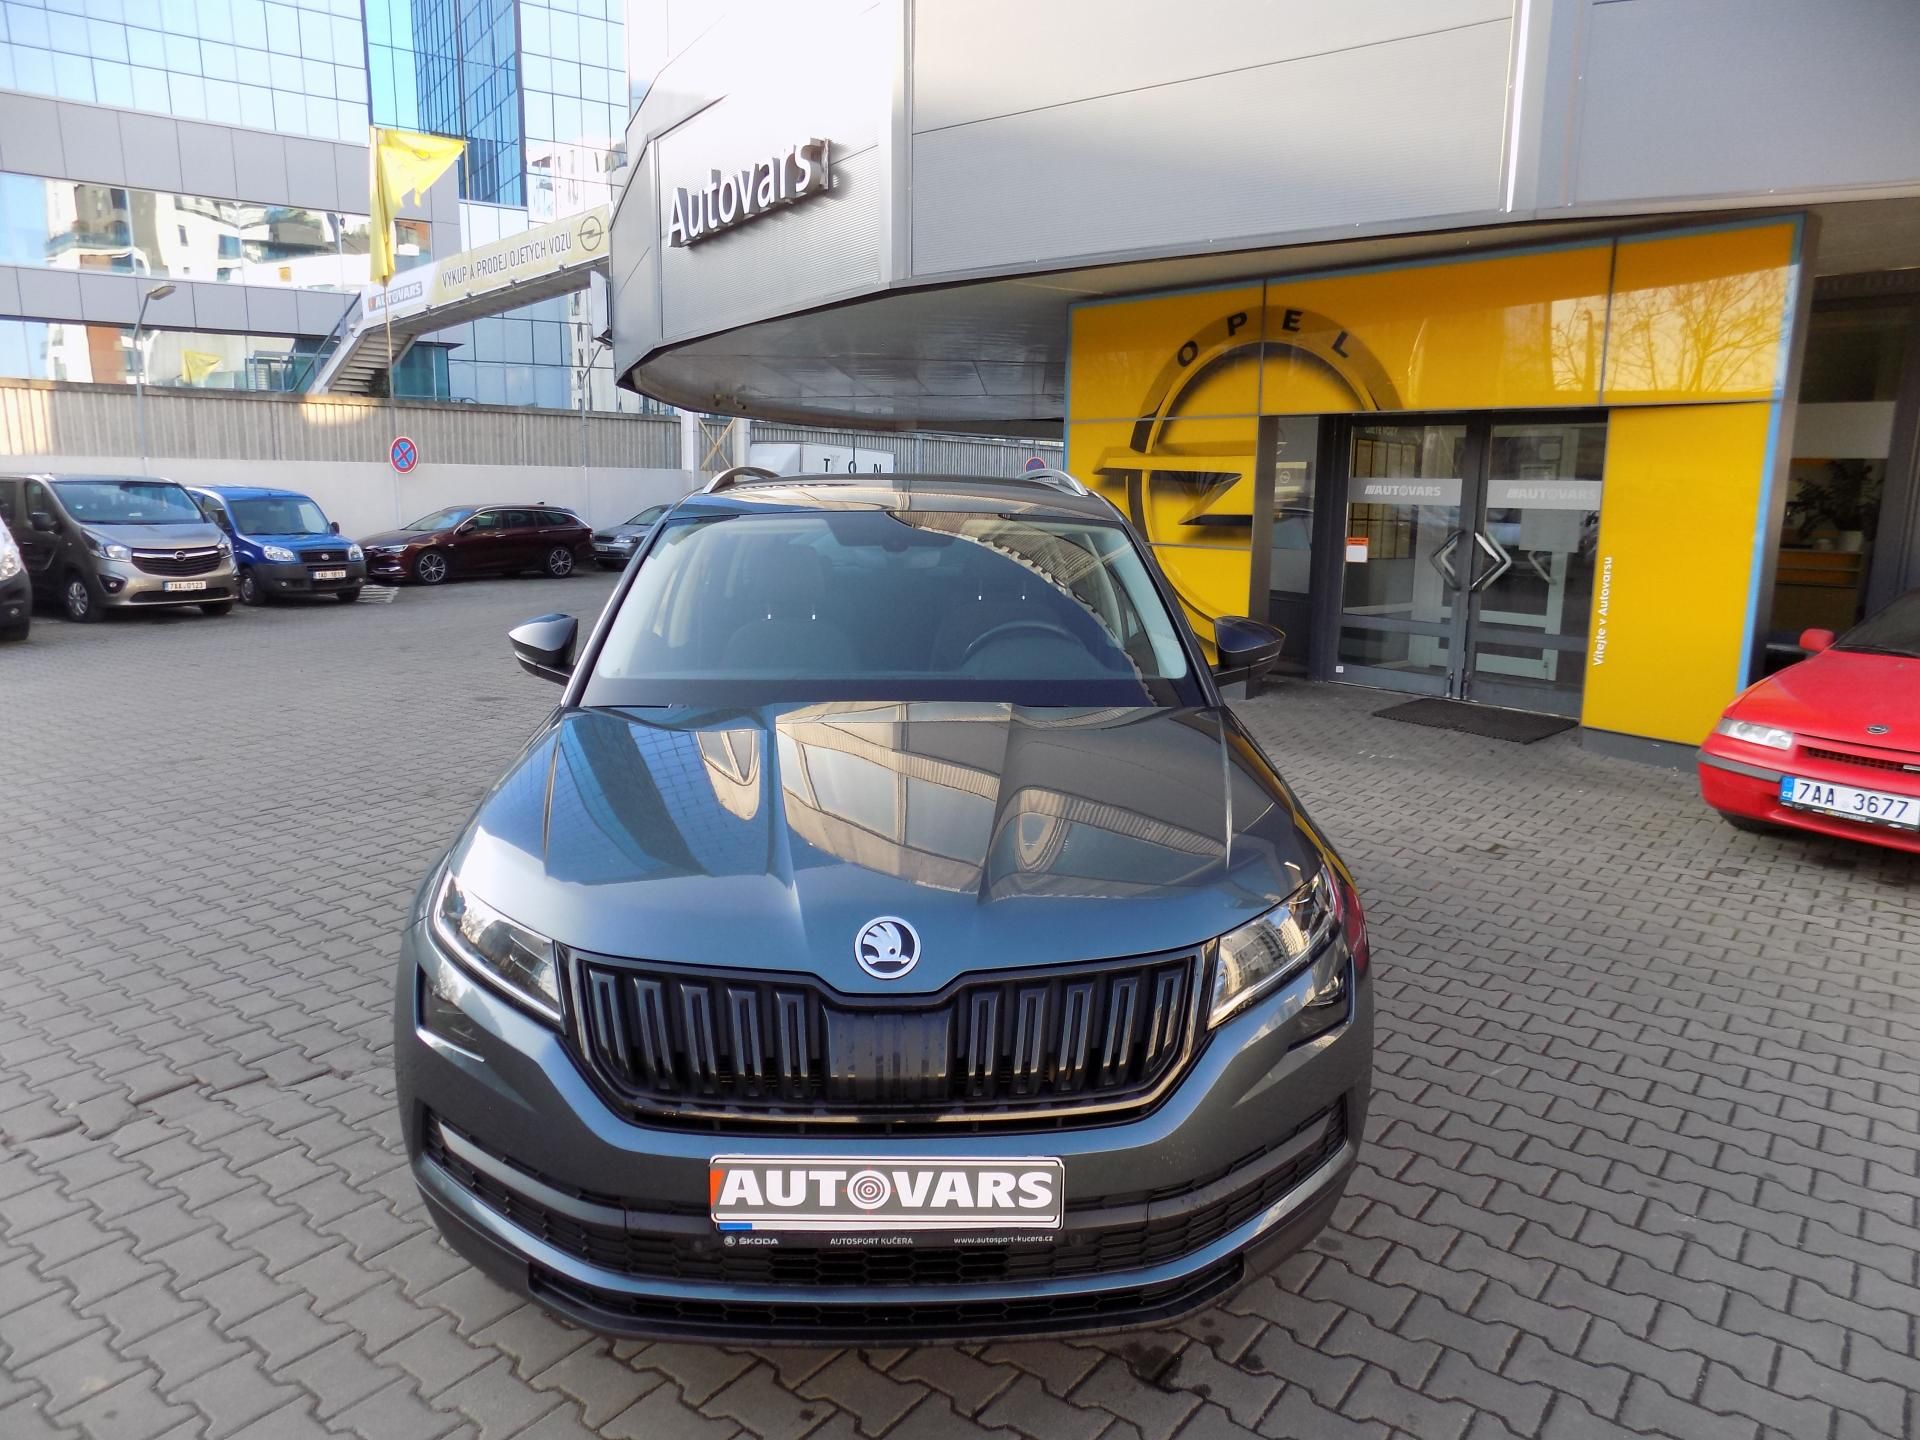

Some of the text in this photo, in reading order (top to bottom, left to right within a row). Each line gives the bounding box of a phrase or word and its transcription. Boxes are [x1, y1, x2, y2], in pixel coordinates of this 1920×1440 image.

[668, 144, 815, 247] Autovars
[469, 264, 476, 280] A
[476, 252, 508, 277] PRODEJ
[1176, 309, 1349, 368] OPEL
[1598, 556, 1613, 616] Autovarsu
[1799, 782, 1835, 806] 7AA
[1853, 793, 1909, 819] 3677
[719, 1169, 1053, 1210] AUTOVARS
[738, 1236, 779, 1246] ŠKODA
[829, 1235, 914, 1246] AUTOSPORT KUČERA
[953, 1235, 1054, 1246] www.autosport-kucera.cz
